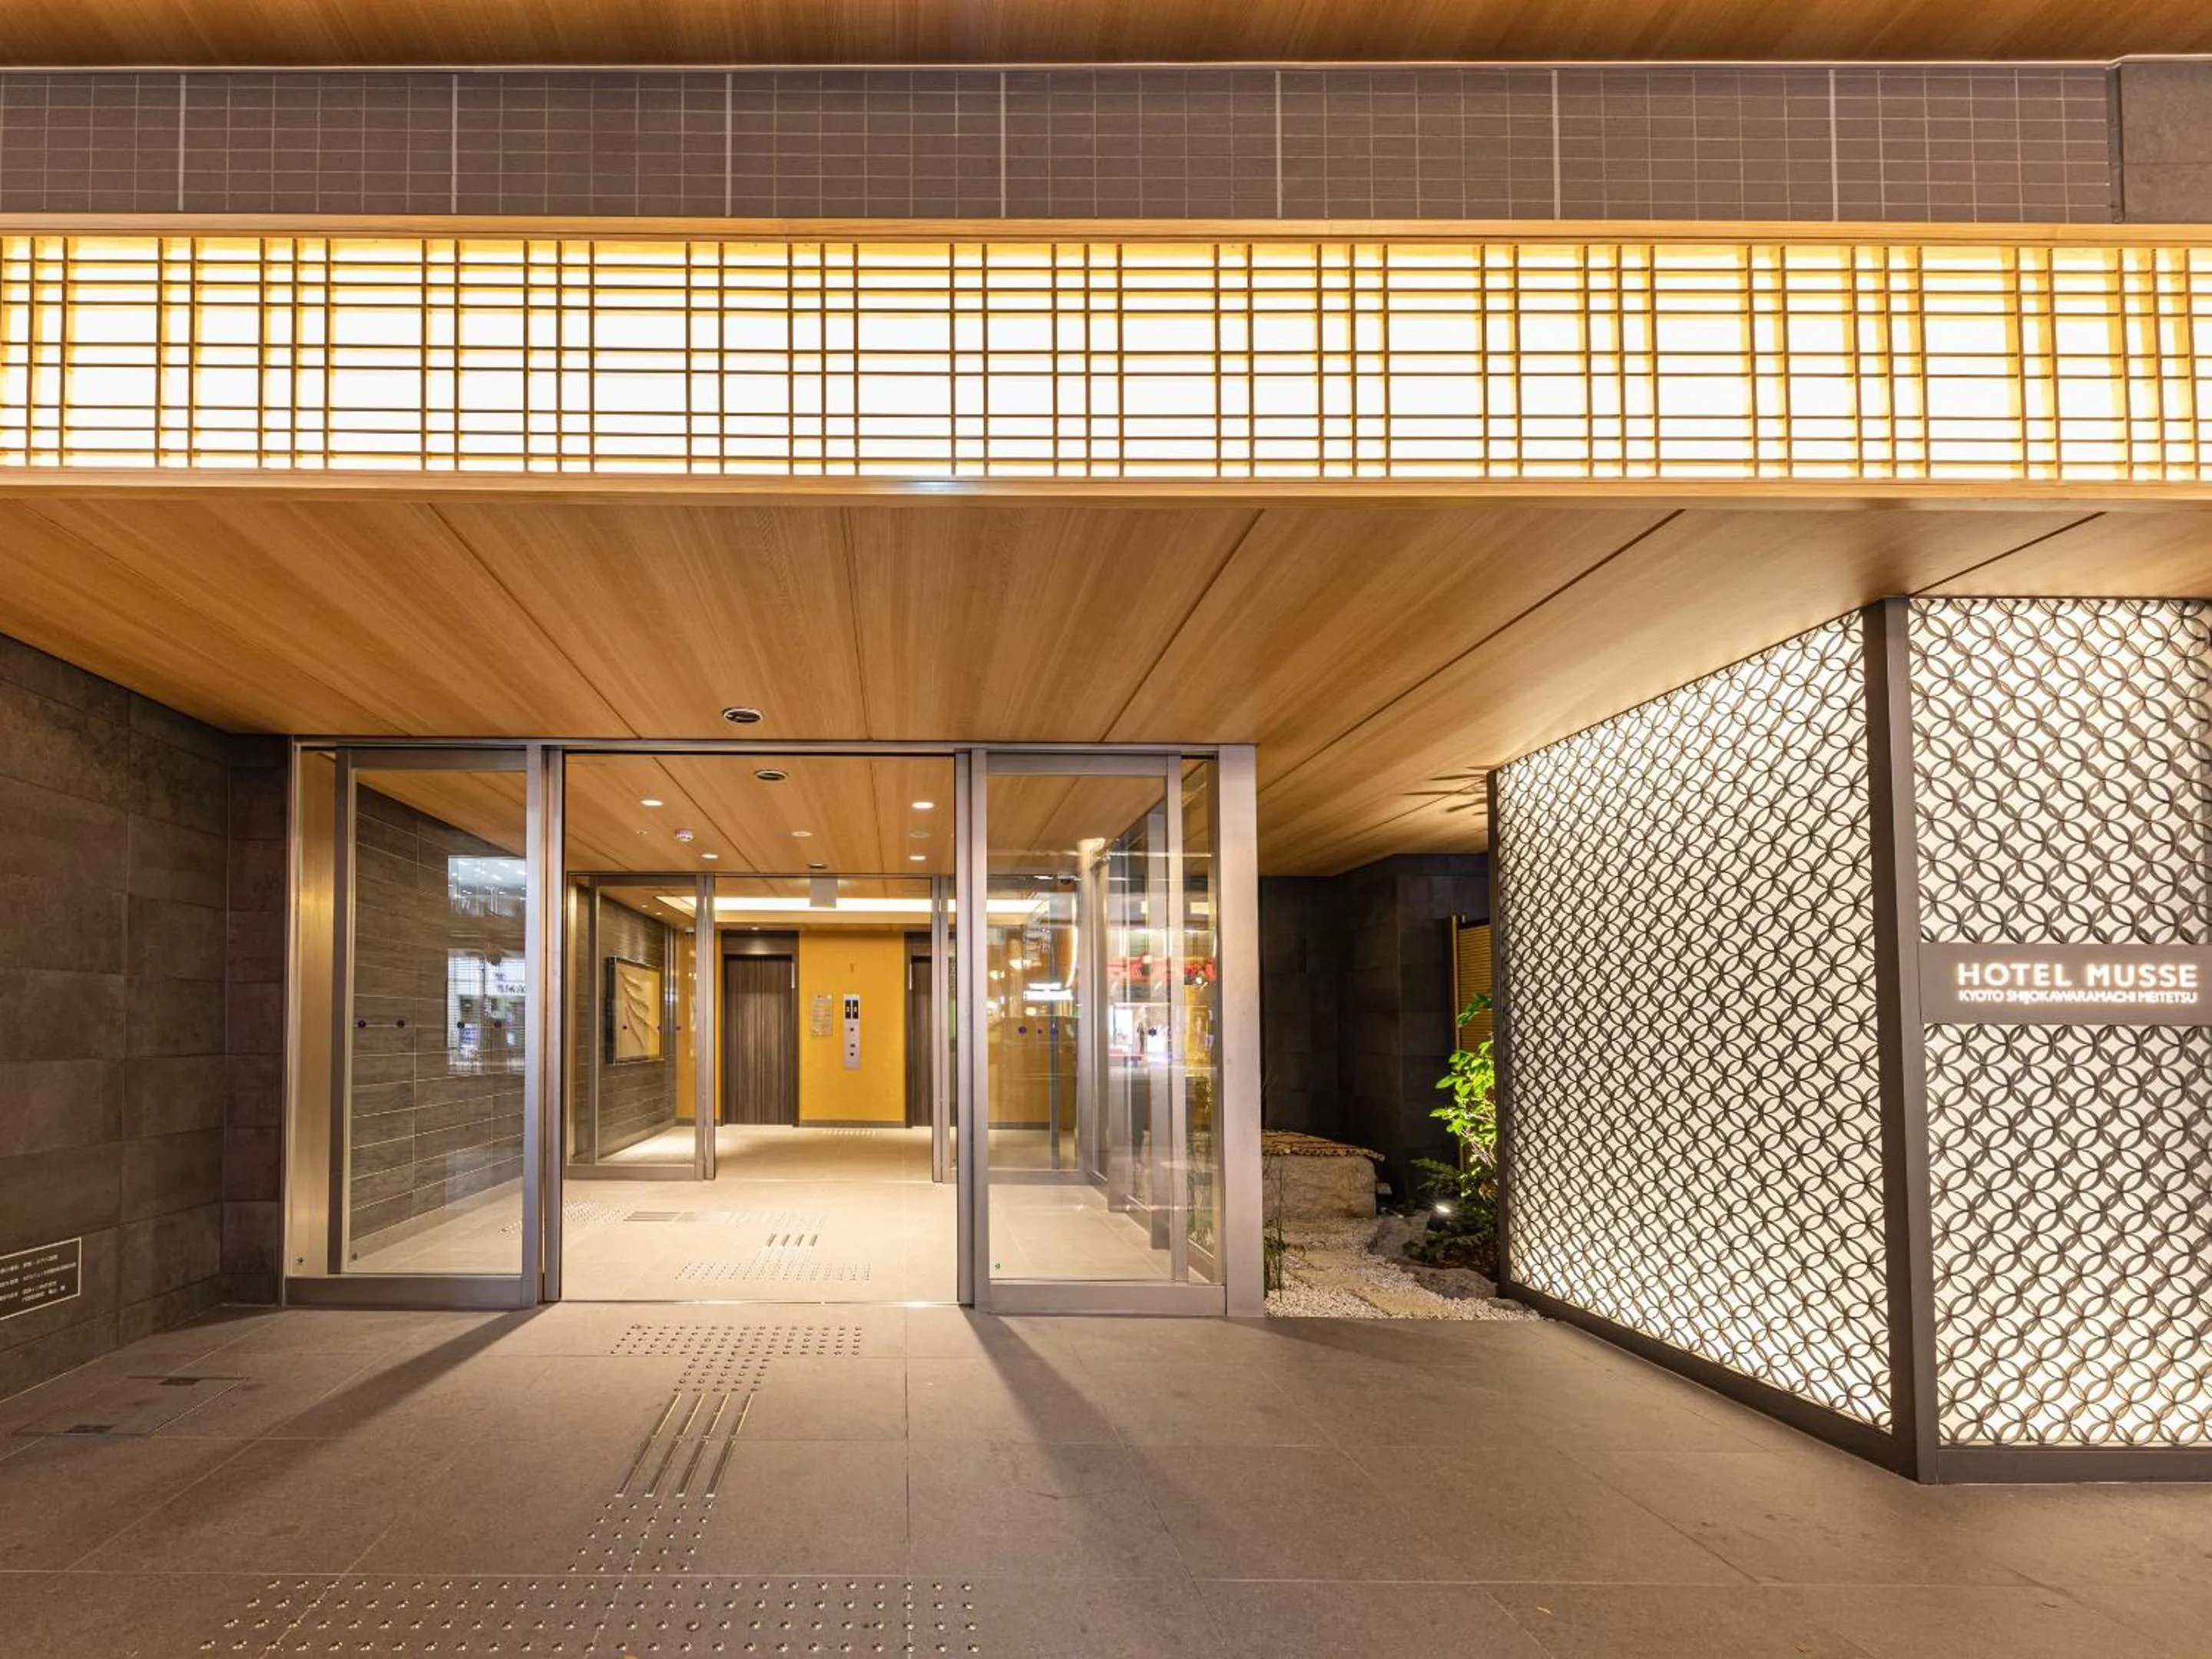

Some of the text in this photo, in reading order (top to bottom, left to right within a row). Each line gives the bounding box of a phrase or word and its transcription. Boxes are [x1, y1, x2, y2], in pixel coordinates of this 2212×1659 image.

[1958, 963, 2198, 988] HOTEL MUSSE
[1959, 989, 2004, 1002] KYOTO
